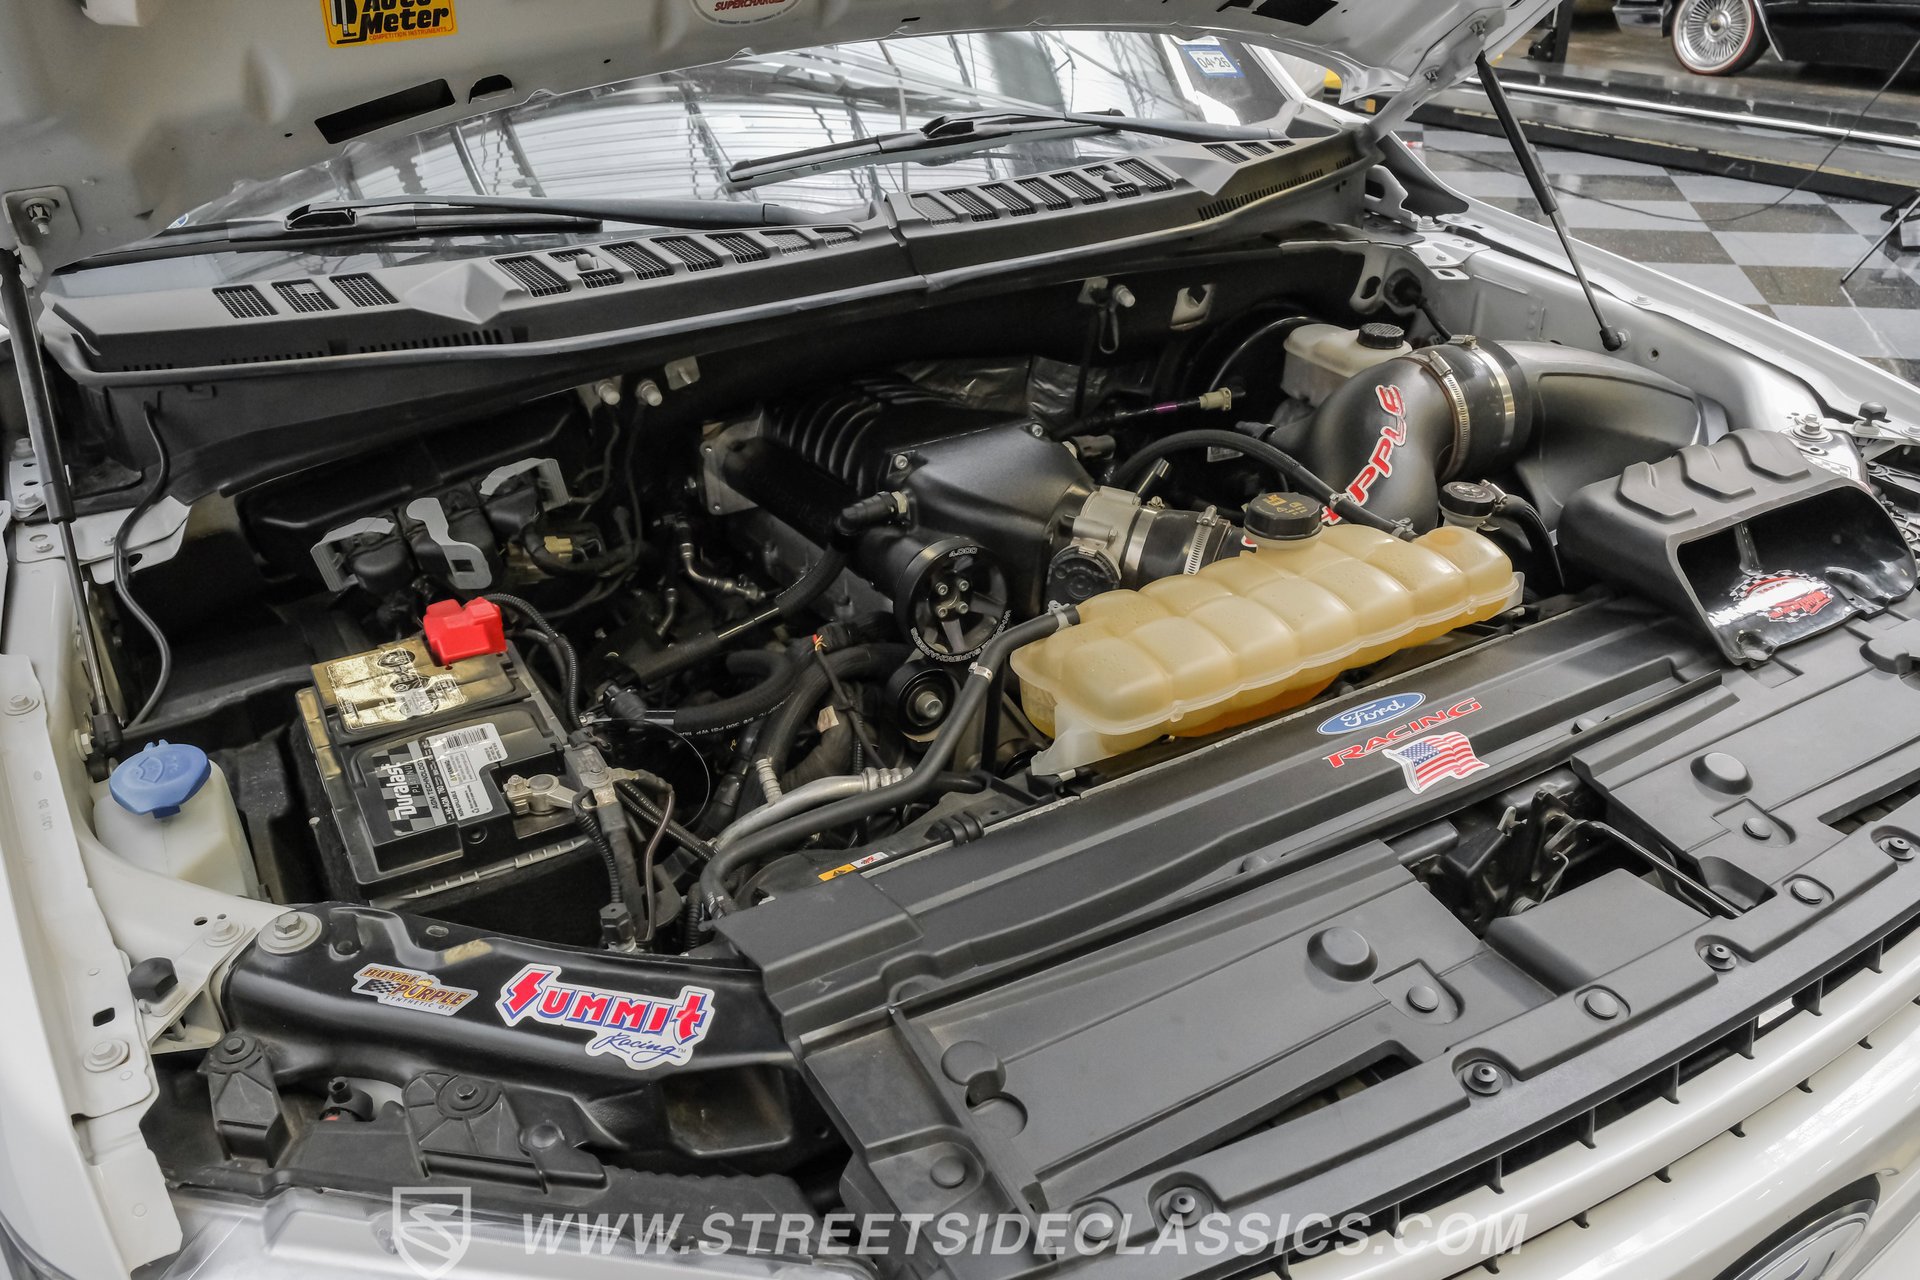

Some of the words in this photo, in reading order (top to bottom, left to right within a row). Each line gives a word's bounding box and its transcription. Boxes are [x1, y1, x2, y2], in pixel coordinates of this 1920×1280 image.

[360, 8, 450, 35] Meter
[369, 32, 407, 41] COMPETITION
[407, 27, 448, 37] INSTRUMENTS
[1340, 700, 1406, 727] Ford
[1322, 697, 1483, 768] RACING
[401, 758, 421, 794] PLATINU
[379, 760, 417, 820] Duralast
[427, 794, 439, 810] AGM
[361, 967, 421, 985] ROYAL
[384, 995, 435, 1008] SYNTHETIC
[438, 1004, 453, 1012] OIL
[388, 983, 472, 1007] PURPLE
[591, 1032, 682, 1063] Racing
